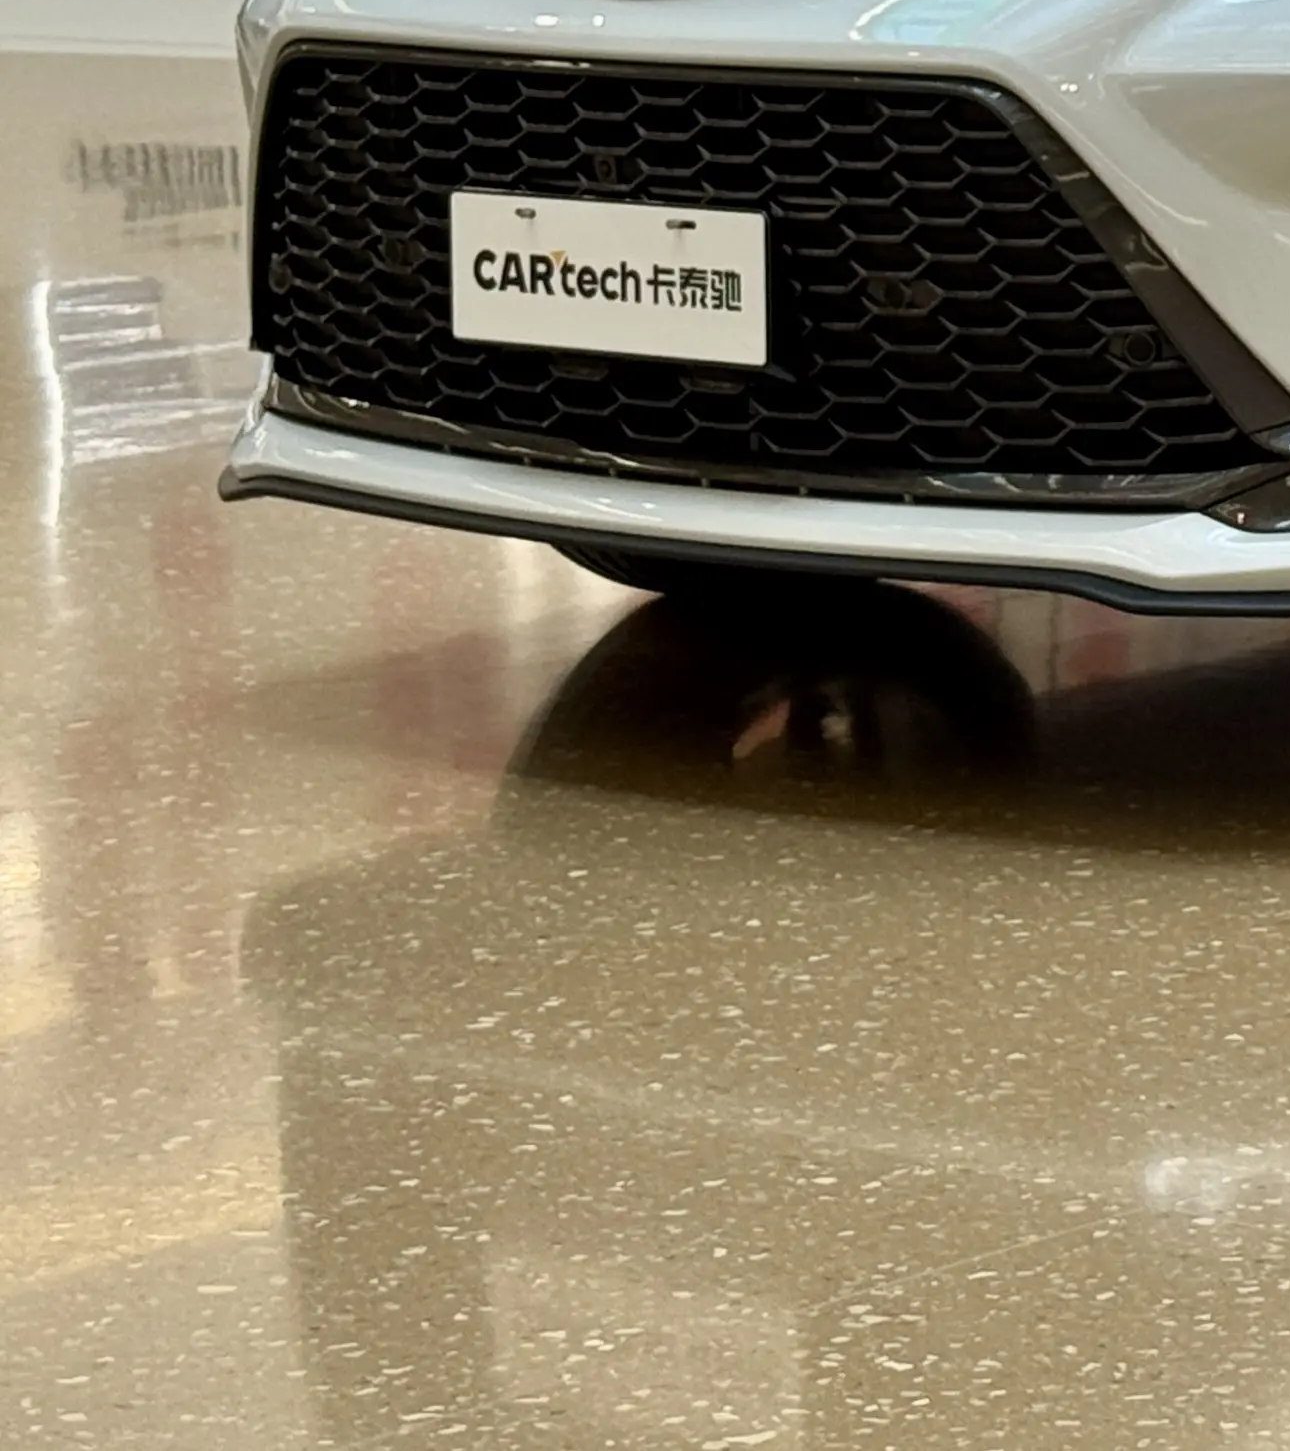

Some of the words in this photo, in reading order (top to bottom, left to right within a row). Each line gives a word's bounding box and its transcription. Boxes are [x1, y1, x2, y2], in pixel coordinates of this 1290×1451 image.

[473, 249, 642, 304] CARtech
[647, 263, 743, 312] 卡泰驰
